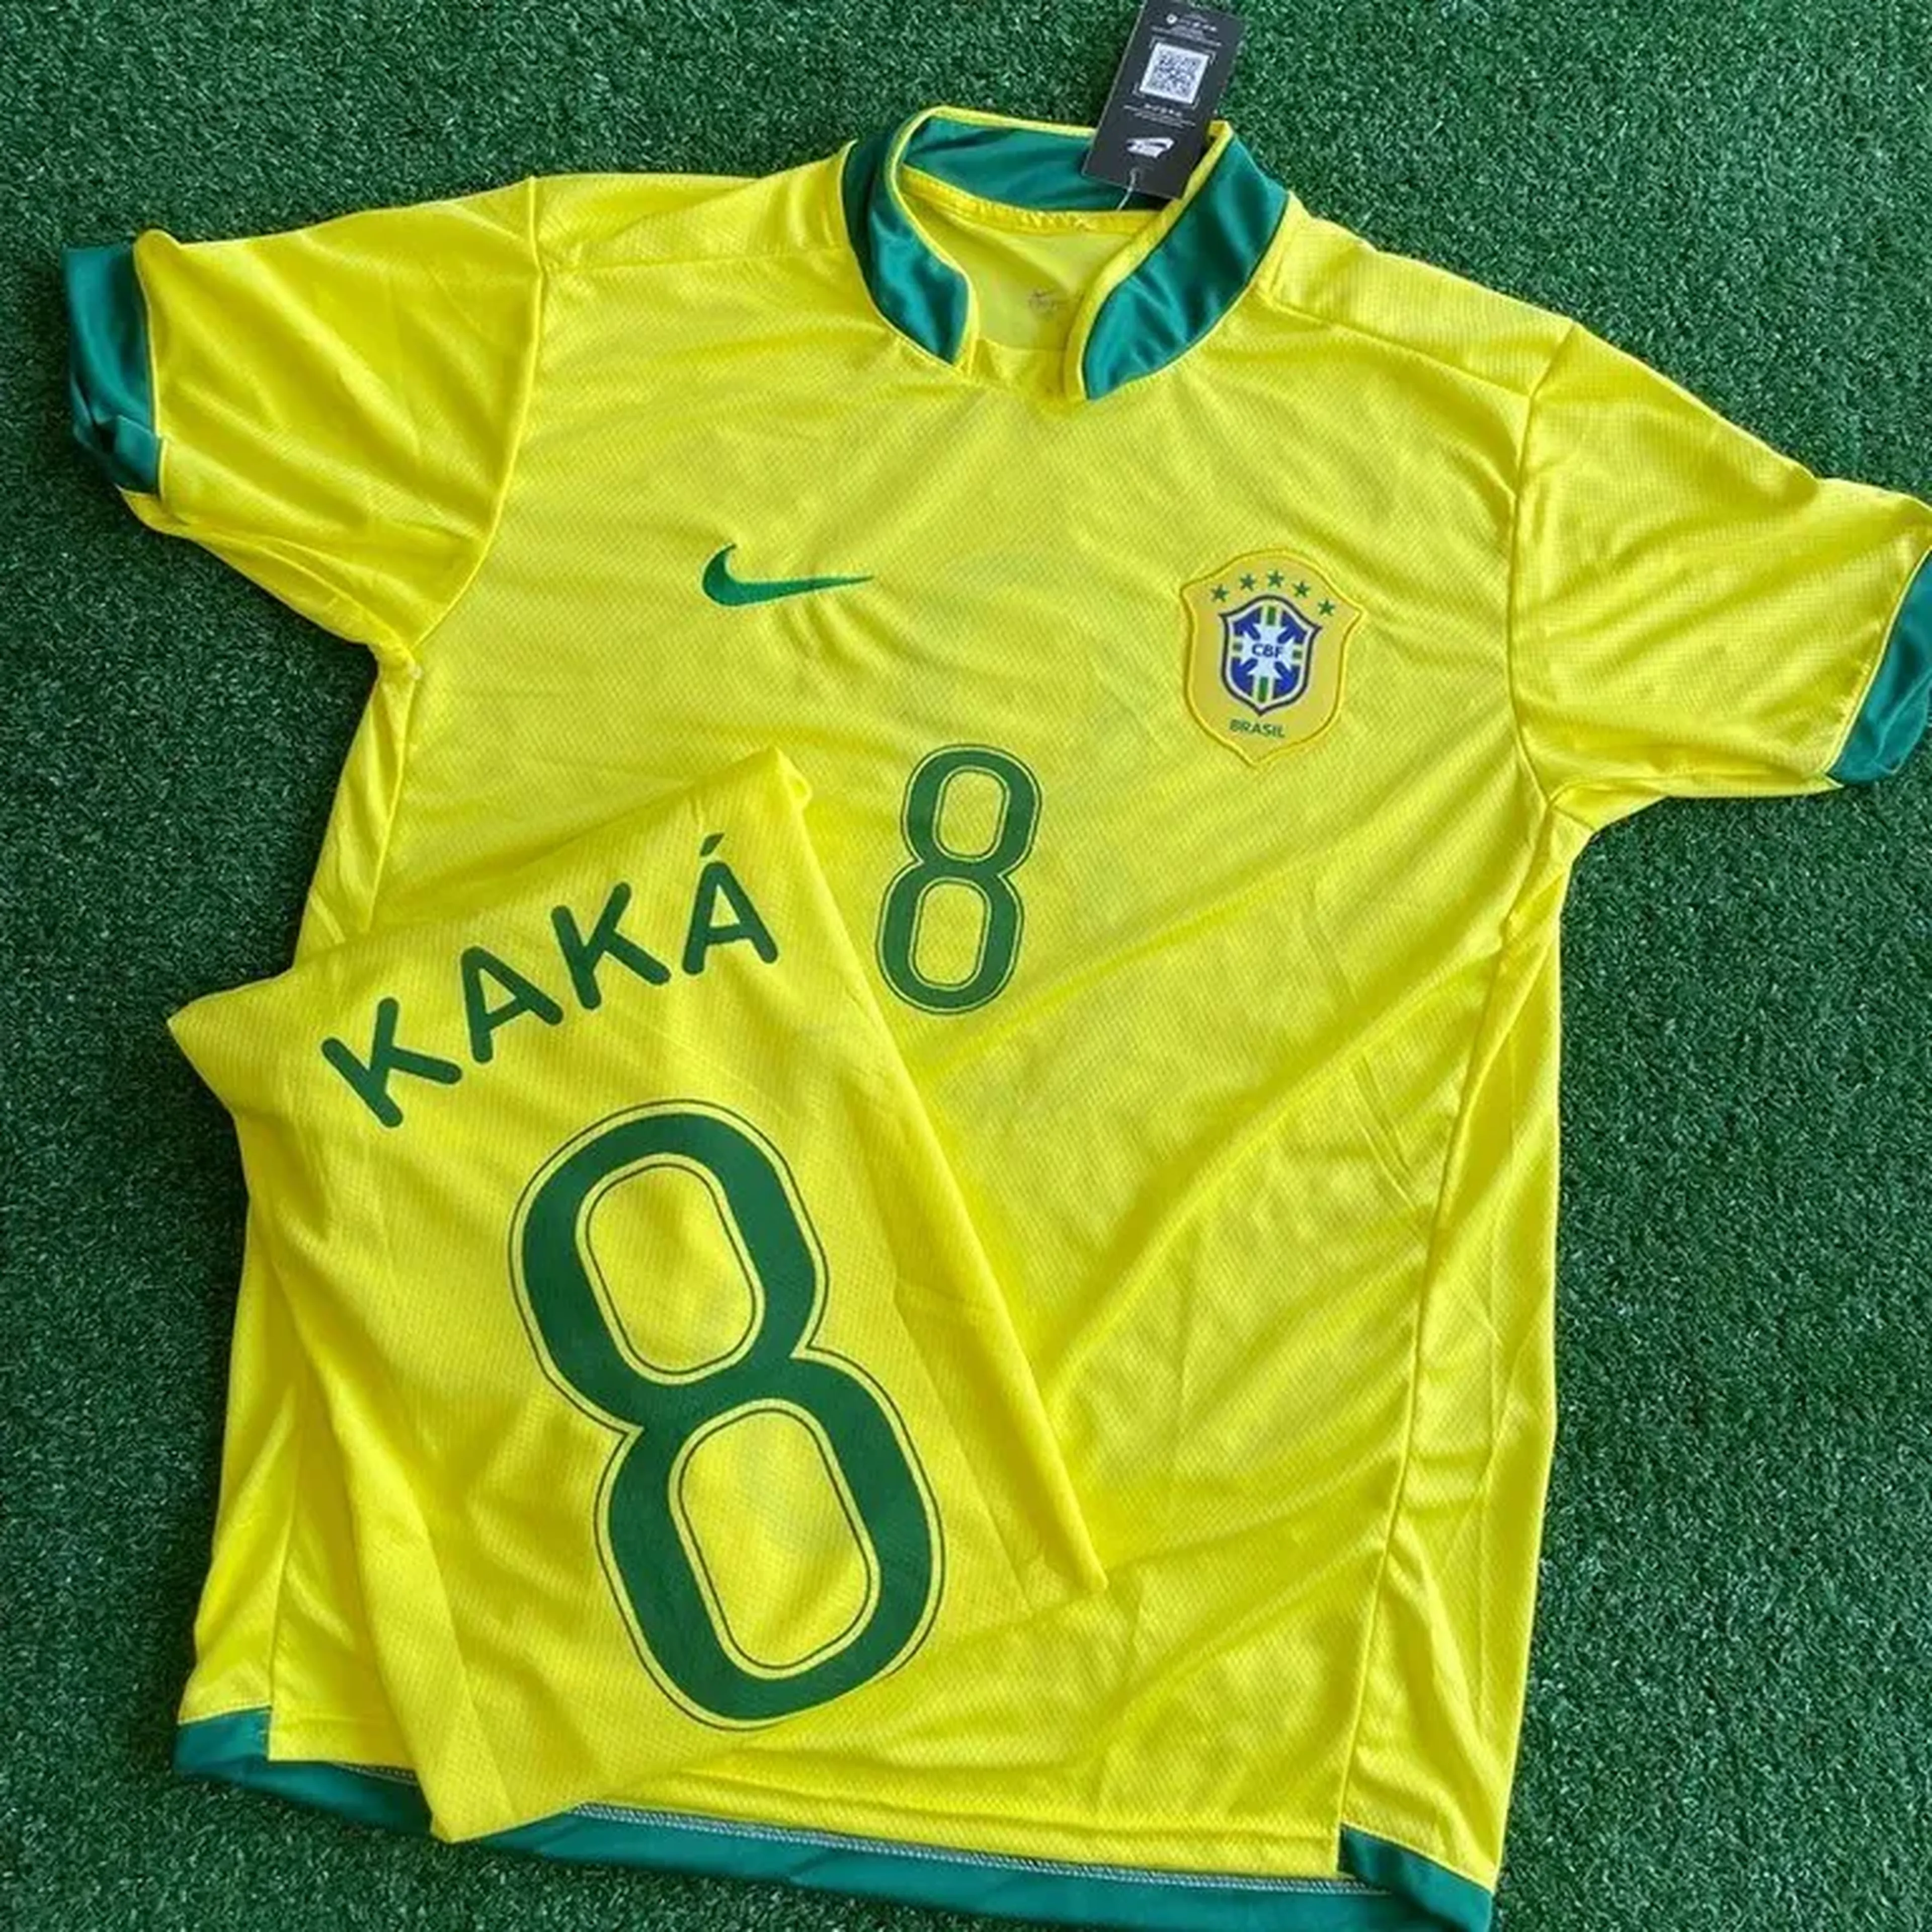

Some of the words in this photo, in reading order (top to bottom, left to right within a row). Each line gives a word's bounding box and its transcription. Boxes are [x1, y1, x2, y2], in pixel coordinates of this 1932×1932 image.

[1230, 719, 1285, 738] BRASIL
[1252, 643, 1283, 659] CBF
[321, 833, 779, 1129] KAKÁ
[875, 744, 1042, 1015] 8
[508, 1099, 945, 1731] 8
